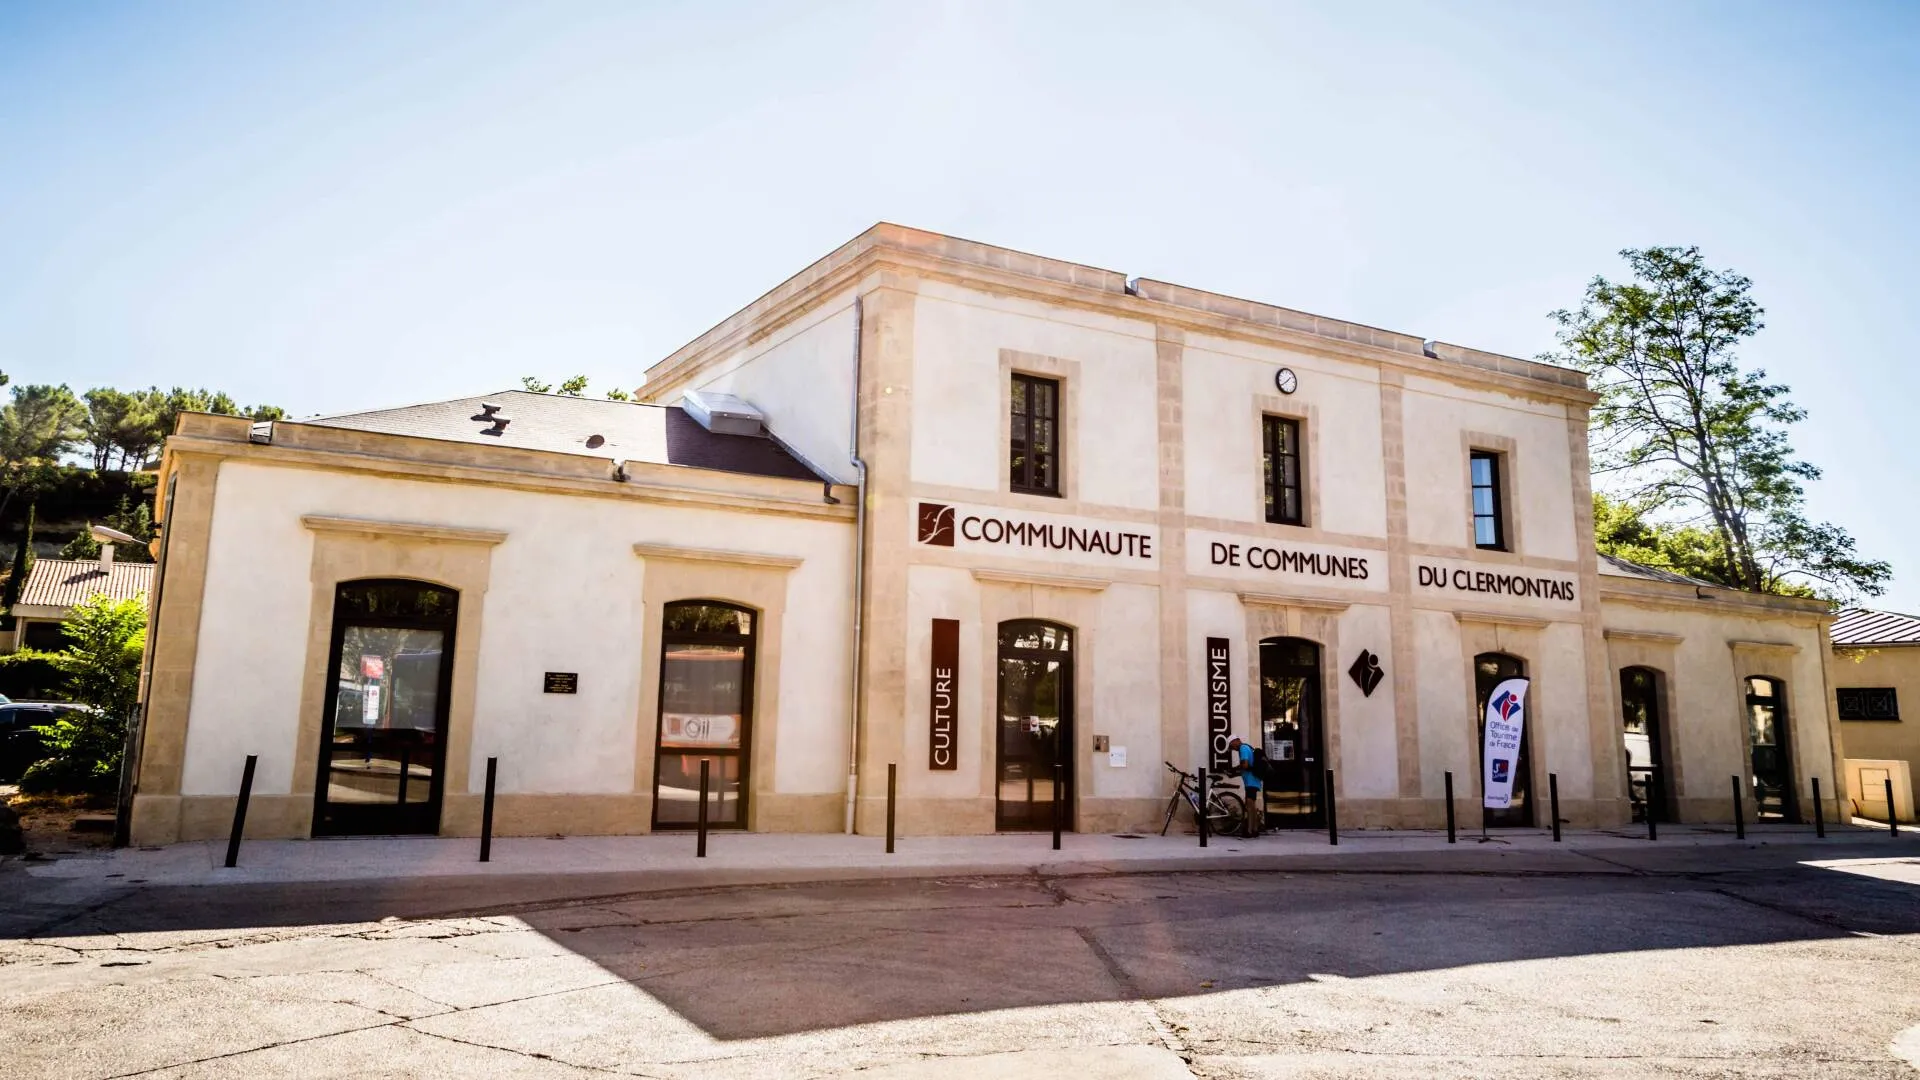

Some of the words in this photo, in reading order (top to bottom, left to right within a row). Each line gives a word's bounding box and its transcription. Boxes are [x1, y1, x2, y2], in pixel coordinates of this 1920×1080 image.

[961, 516, 1152, 559] COMMUNAUTE
[1211, 542, 1240, 567] DE
[1247, 546, 1369, 580] COMMUNES
[1418, 565, 1447, 588] DU
[1453, 569, 1575, 601] CLERMONTAIS
[934, 667, 951, 766] CULTURE
[1211, 647, 1230, 769] TOURISME
[1490, 721, 1510, 730] Office
